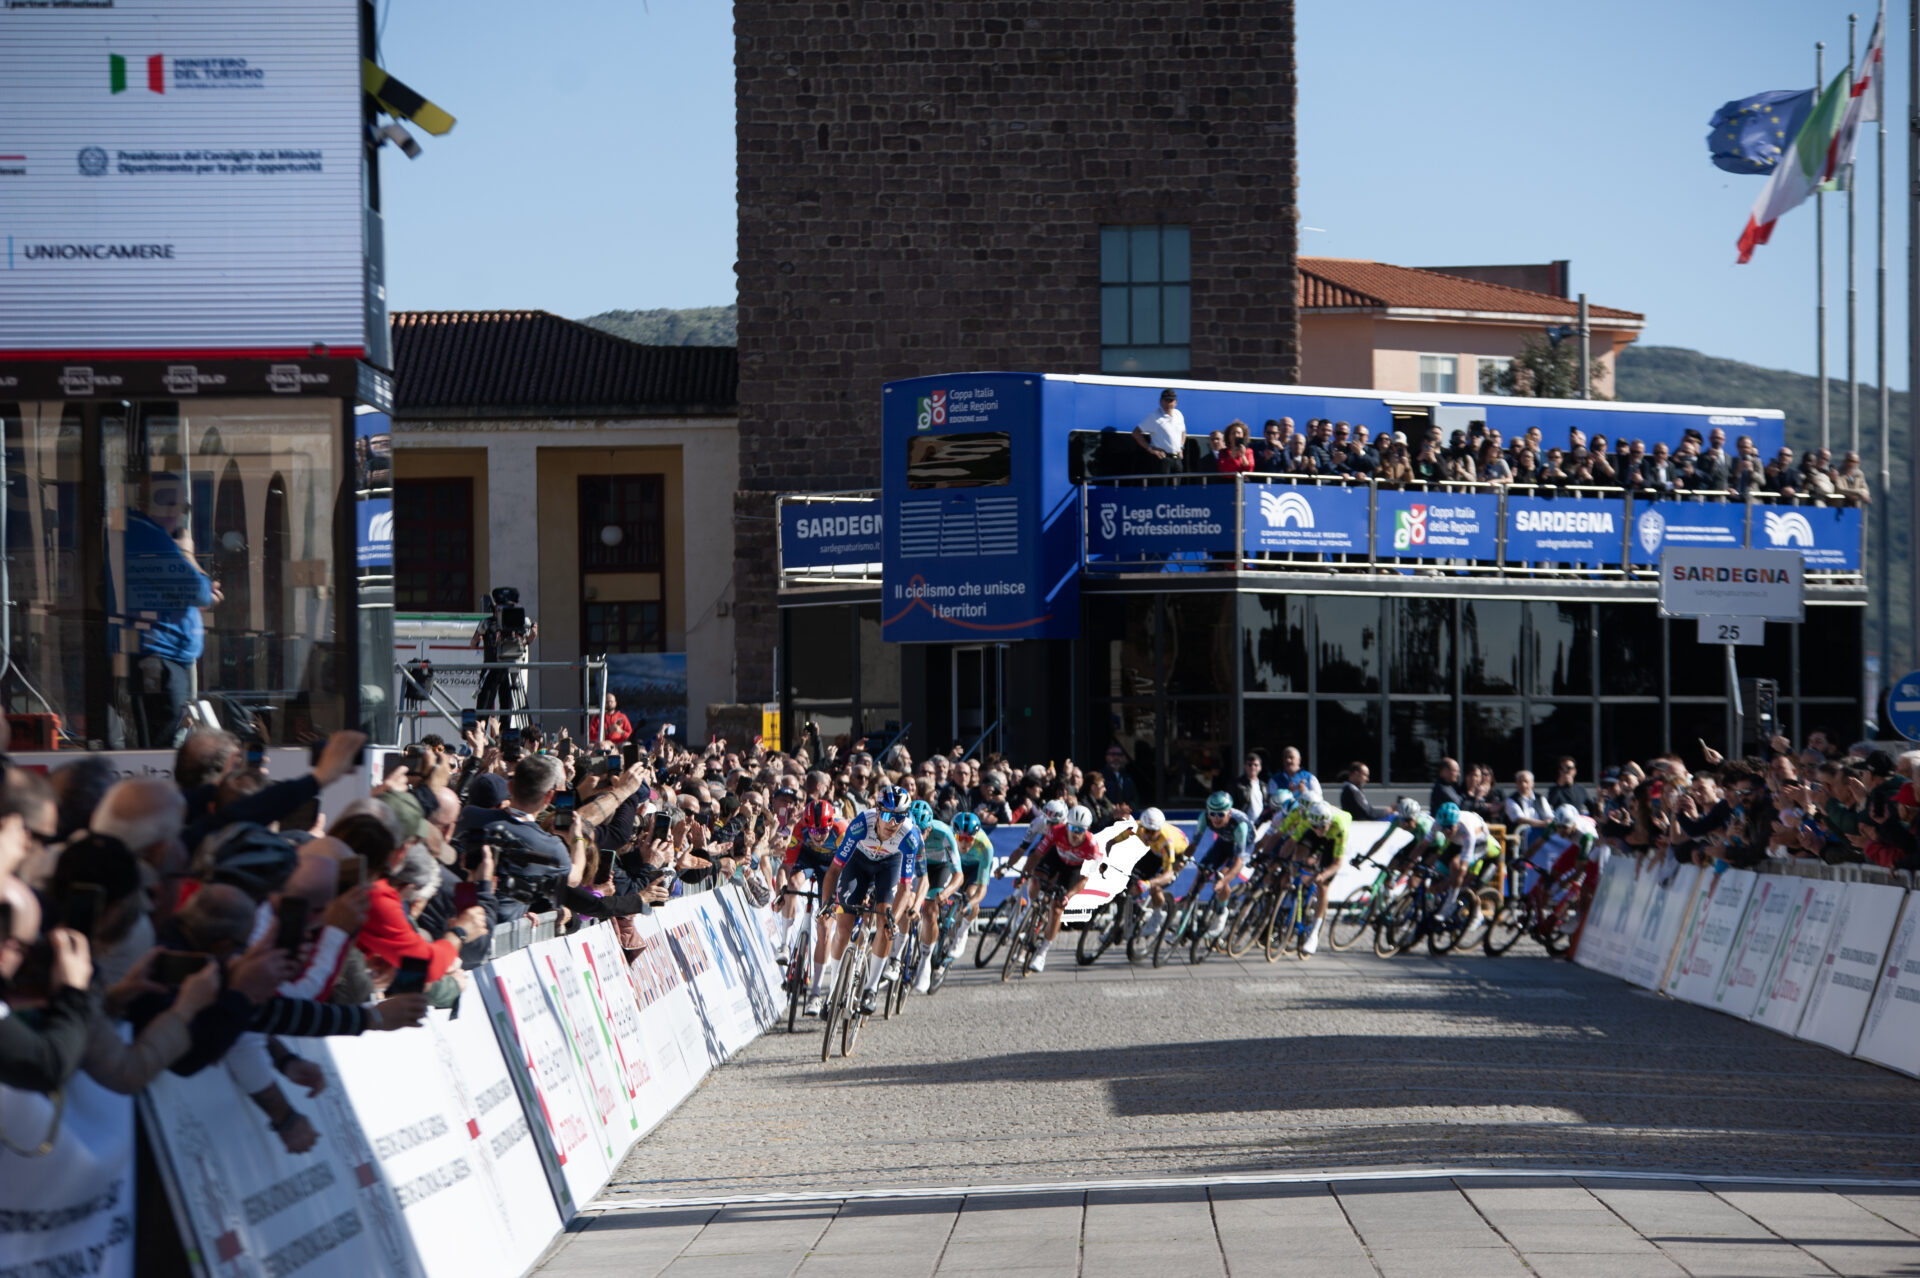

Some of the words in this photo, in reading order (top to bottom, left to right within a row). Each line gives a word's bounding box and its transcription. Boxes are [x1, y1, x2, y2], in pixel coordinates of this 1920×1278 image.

[174, 59, 247, 68] MINISTERO
[174, 70, 199, 79] DEL
[204, 69, 264, 79] TURISMO
[24, 244, 175, 259] UNIONCAMERE
[950, 390, 973, 400] Coppa
[974, 388, 994, 398] Italia
[950, 402, 968, 412] delle
[970, 400, 998, 413] Regioni
[1122, 505, 1153, 522] Lega
[1156, 503, 1211, 519] Ciclismo
[1430, 505, 1454, 519] Coppa
[1455, 506, 1476, 519] Italia
[1122, 520, 1222, 536] Professionistico
[1429, 520, 1449, 532] delle
[1450, 520, 1480, 535] Regioni
[1515, 510, 1614, 533] SARDEGNA
[1673, 566, 1791, 584] SARDEGNA
[895, 585, 902, 599] Il
[905, 583, 956, 598] ciclismo
[958, 582, 981, 596] che
[984, 580, 1026, 595] unisce
[932, 604, 937, 618] i
[938, 602, 987, 618] territori
[1718, 625, 1740, 640] 25
[840, 837, 855, 858] BOSS
[905, 853, 914, 873] BOSS
